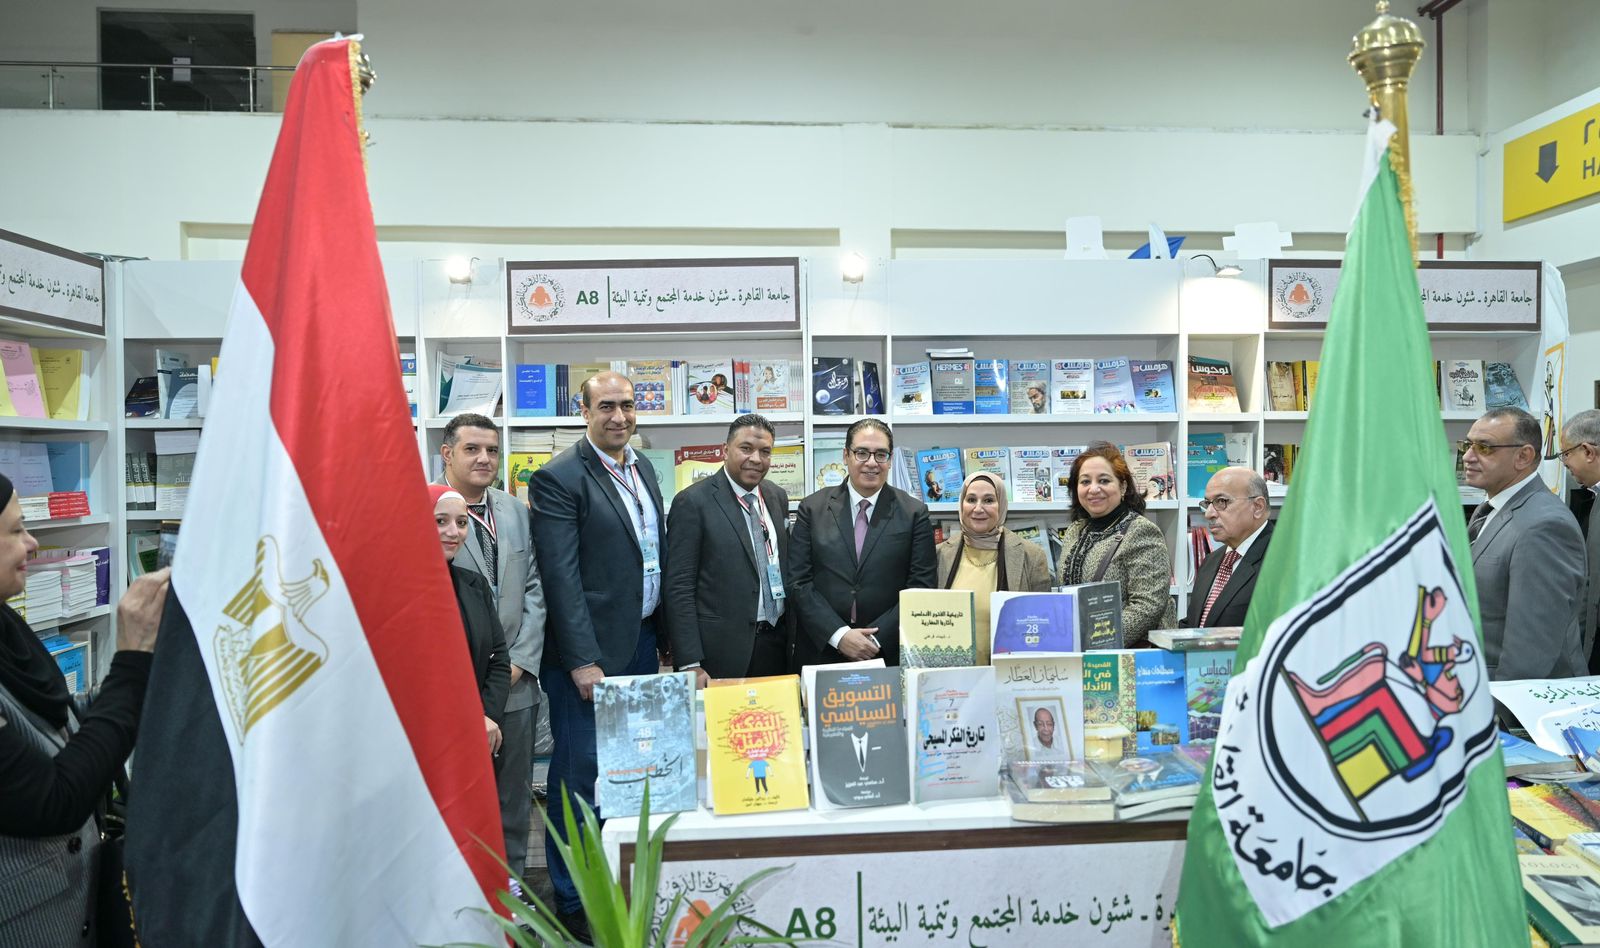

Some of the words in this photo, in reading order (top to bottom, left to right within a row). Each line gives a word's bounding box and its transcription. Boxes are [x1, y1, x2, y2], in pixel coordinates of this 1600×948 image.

[28, 273, 44, 289] خدمة
[576, 290, 599, 305] A8
[612, 289, 630, 307] البيئة
[633, 289, 652, 306] وتنمية
[656, 288, 679, 312] المجتمع
[683, 289, 705, 301] خدمة
[709, 288, 729, 306] شئون
[738, 287, 763, 306] القاهرة
[767, 286, 790, 303] جامعة
[1433, 290, 1452, 303] خدمة
[1456, 290, 1475, 308] شئون
[1484, 288, 1507, 309] القاهرة
[1511, 288, 1532, 307] جامعة
[936, 363, 963, 371] HERMES
[1140, 363, 1168, 372] هرمس
[1026, 624, 1039, 634] 28
[1093, 670, 1112, 682] في
[822, 684, 891, 708] التسويق
[820, 703, 896, 728] السياسي
[949, 727, 965, 747] الفكر
[966, 725, 985, 748] تاريخ
[868, 900, 908, 942] البيئة
[917, 899, 958, 939] وتنمية
[968, 893, 1022, 948] المجتمع
[1031, 898, 1079, 926] خدمة
[1089, 893, 1133, 934] شئون
[785, 907, 836, 939] A8
